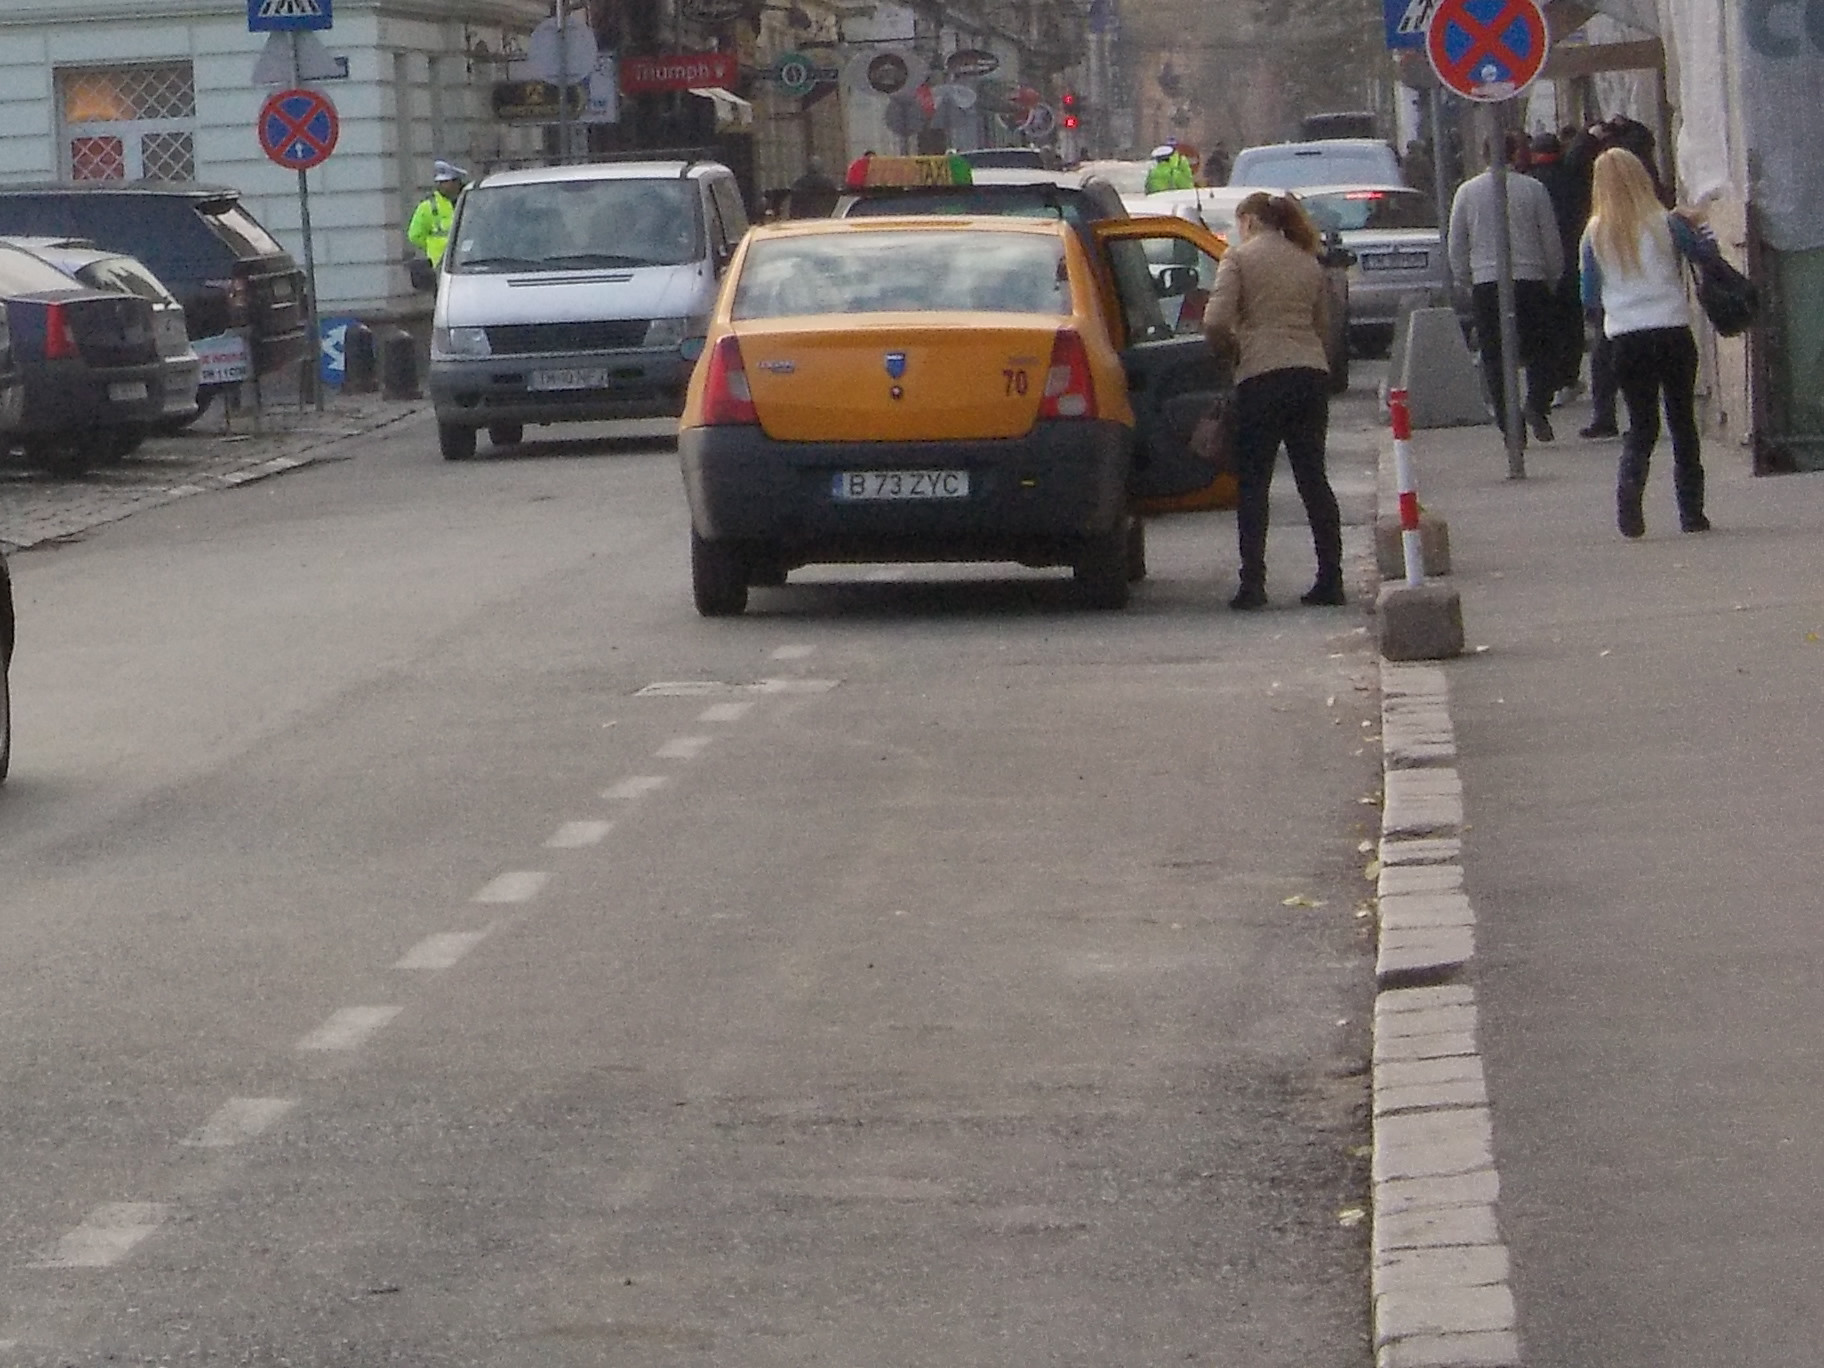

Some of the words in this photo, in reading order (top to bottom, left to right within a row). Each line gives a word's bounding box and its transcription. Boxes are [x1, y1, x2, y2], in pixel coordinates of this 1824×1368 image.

[633, 62, 710, 88] Triumph
[1002, 368, 1029, 397] 70
[849, 474, 865, 496] B
[874, 474, 903, 495] 73
[909, 472, 959, 494] ZYC
